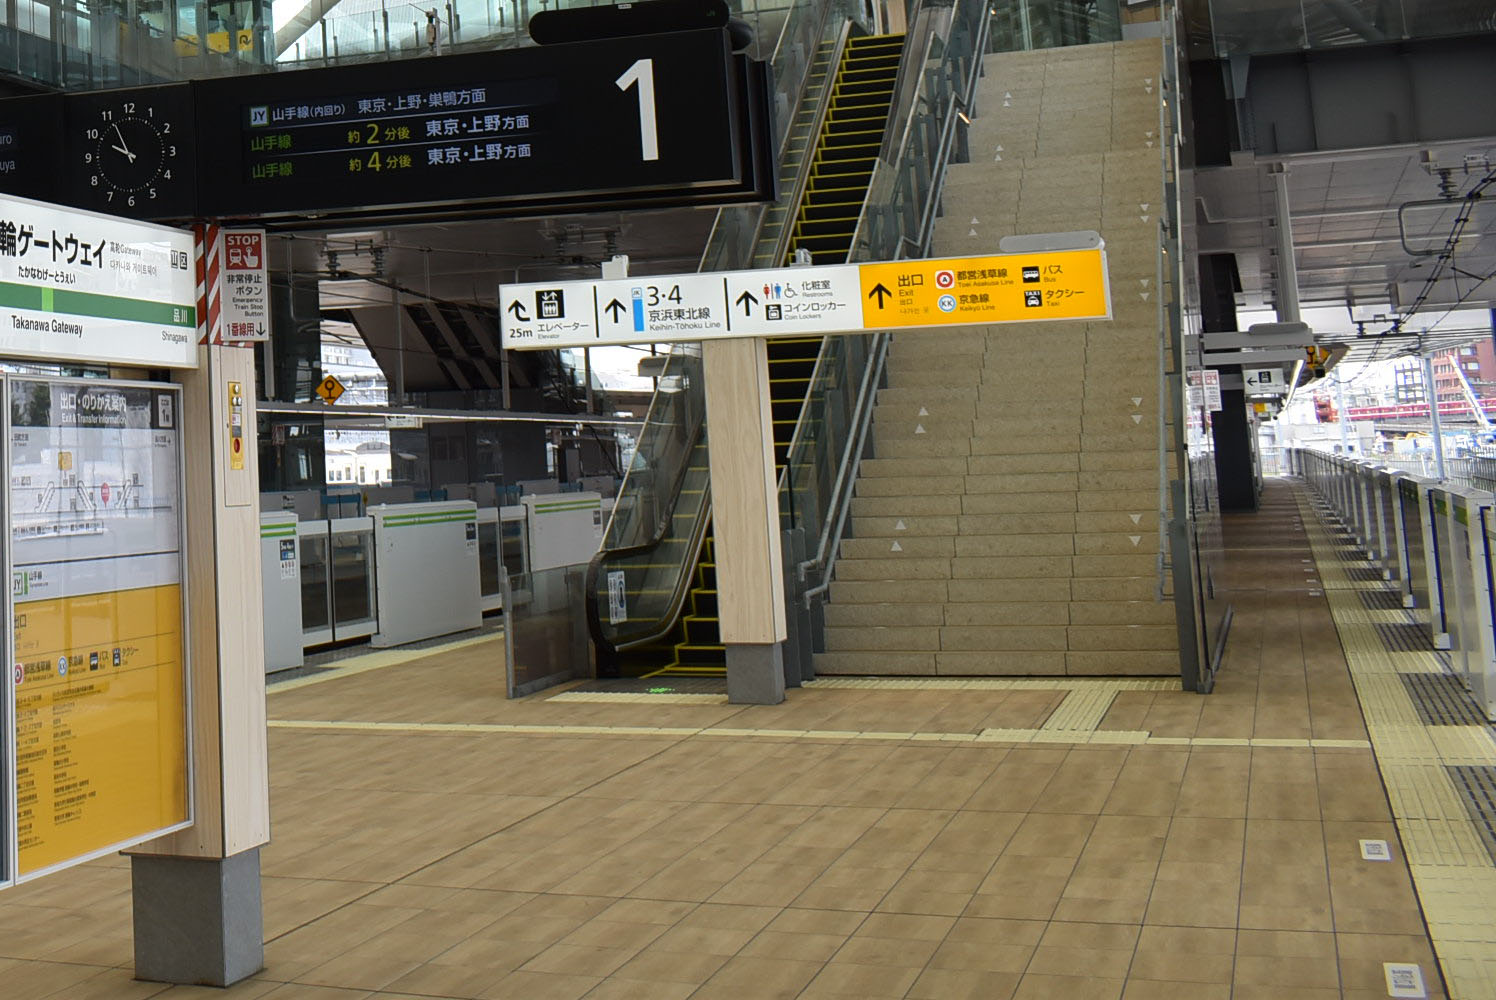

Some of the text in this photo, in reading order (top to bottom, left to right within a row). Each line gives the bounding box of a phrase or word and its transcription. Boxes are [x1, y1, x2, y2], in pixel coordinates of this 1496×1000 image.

[124, 102, 136, 114] 12
[252, 88, 486, 123] JY 山手線(内回り) 東京・上野・巣鴨方面
[615, 58, 659, 161] 1
[101, 110, 112, 121] 11
[147, 107, 153, 118] 1
[86, 128, 99, 139] 10
[163, 122, 171, 134] 2
[251, 133, 292, 151] 山手線
[426, 114, 530, 136] 東京・上野方面
[169, 145, 176, 157] 3
[84, 152, 92, 163] 9
[252, 161, 294, 178] 山手線
[427, 143, 532, 166] 東京・上野方面
[164, 169, 172, 180] 4
[90, 175, 98, 186] 8
[106, 191, 114, 202] 7
[149, 188, 157, 199] 5
[127, 195, 135, 207] 6
[228, 235, 260, 246] STOP
[18, 265, 76, 285] たかなわげーとうぇい
[957, 268, 1008, 281] 都営浅草線
[1043, 265, 1064, 275] バス
[226, 273, 263, 284] 非常停止
[898, 274, 924, 287] 出口
[235, 285, 263, 296] ボタン
[801, 280, 831, 291] 化粧室
[802, 290, 834, 298] Restrooms
[899, 289, 914, 297] Exit
[959, 293, 989, 304] 京急線
[1045, 289, 1085, 299] タクシー
[784, 301, 846, 314] コインロッカー
[173, 308, 188, 323] 品川
[648, 307, 711, 323] 京浜東北線
[798, 312, 822, 320] Lockers
[11, 314, 83, 337] Takanawa Gateway
[227, 322, 255, 337] 1番線用
[537, 322, 589, 333] エレベーター
[704, 320, 721, 329] Line
[162, 330, 188, 345] Shinagawa
[509, 328, 533, 339] 25m
[537, 332, 560, 340] Elevator
[60, 392, 127, 412] 出口・のりかえ案内
[61, 413, 72, 423] Exit
[77, 413, 98, 424] Transfer
[98, 414, 127, 425] Information
